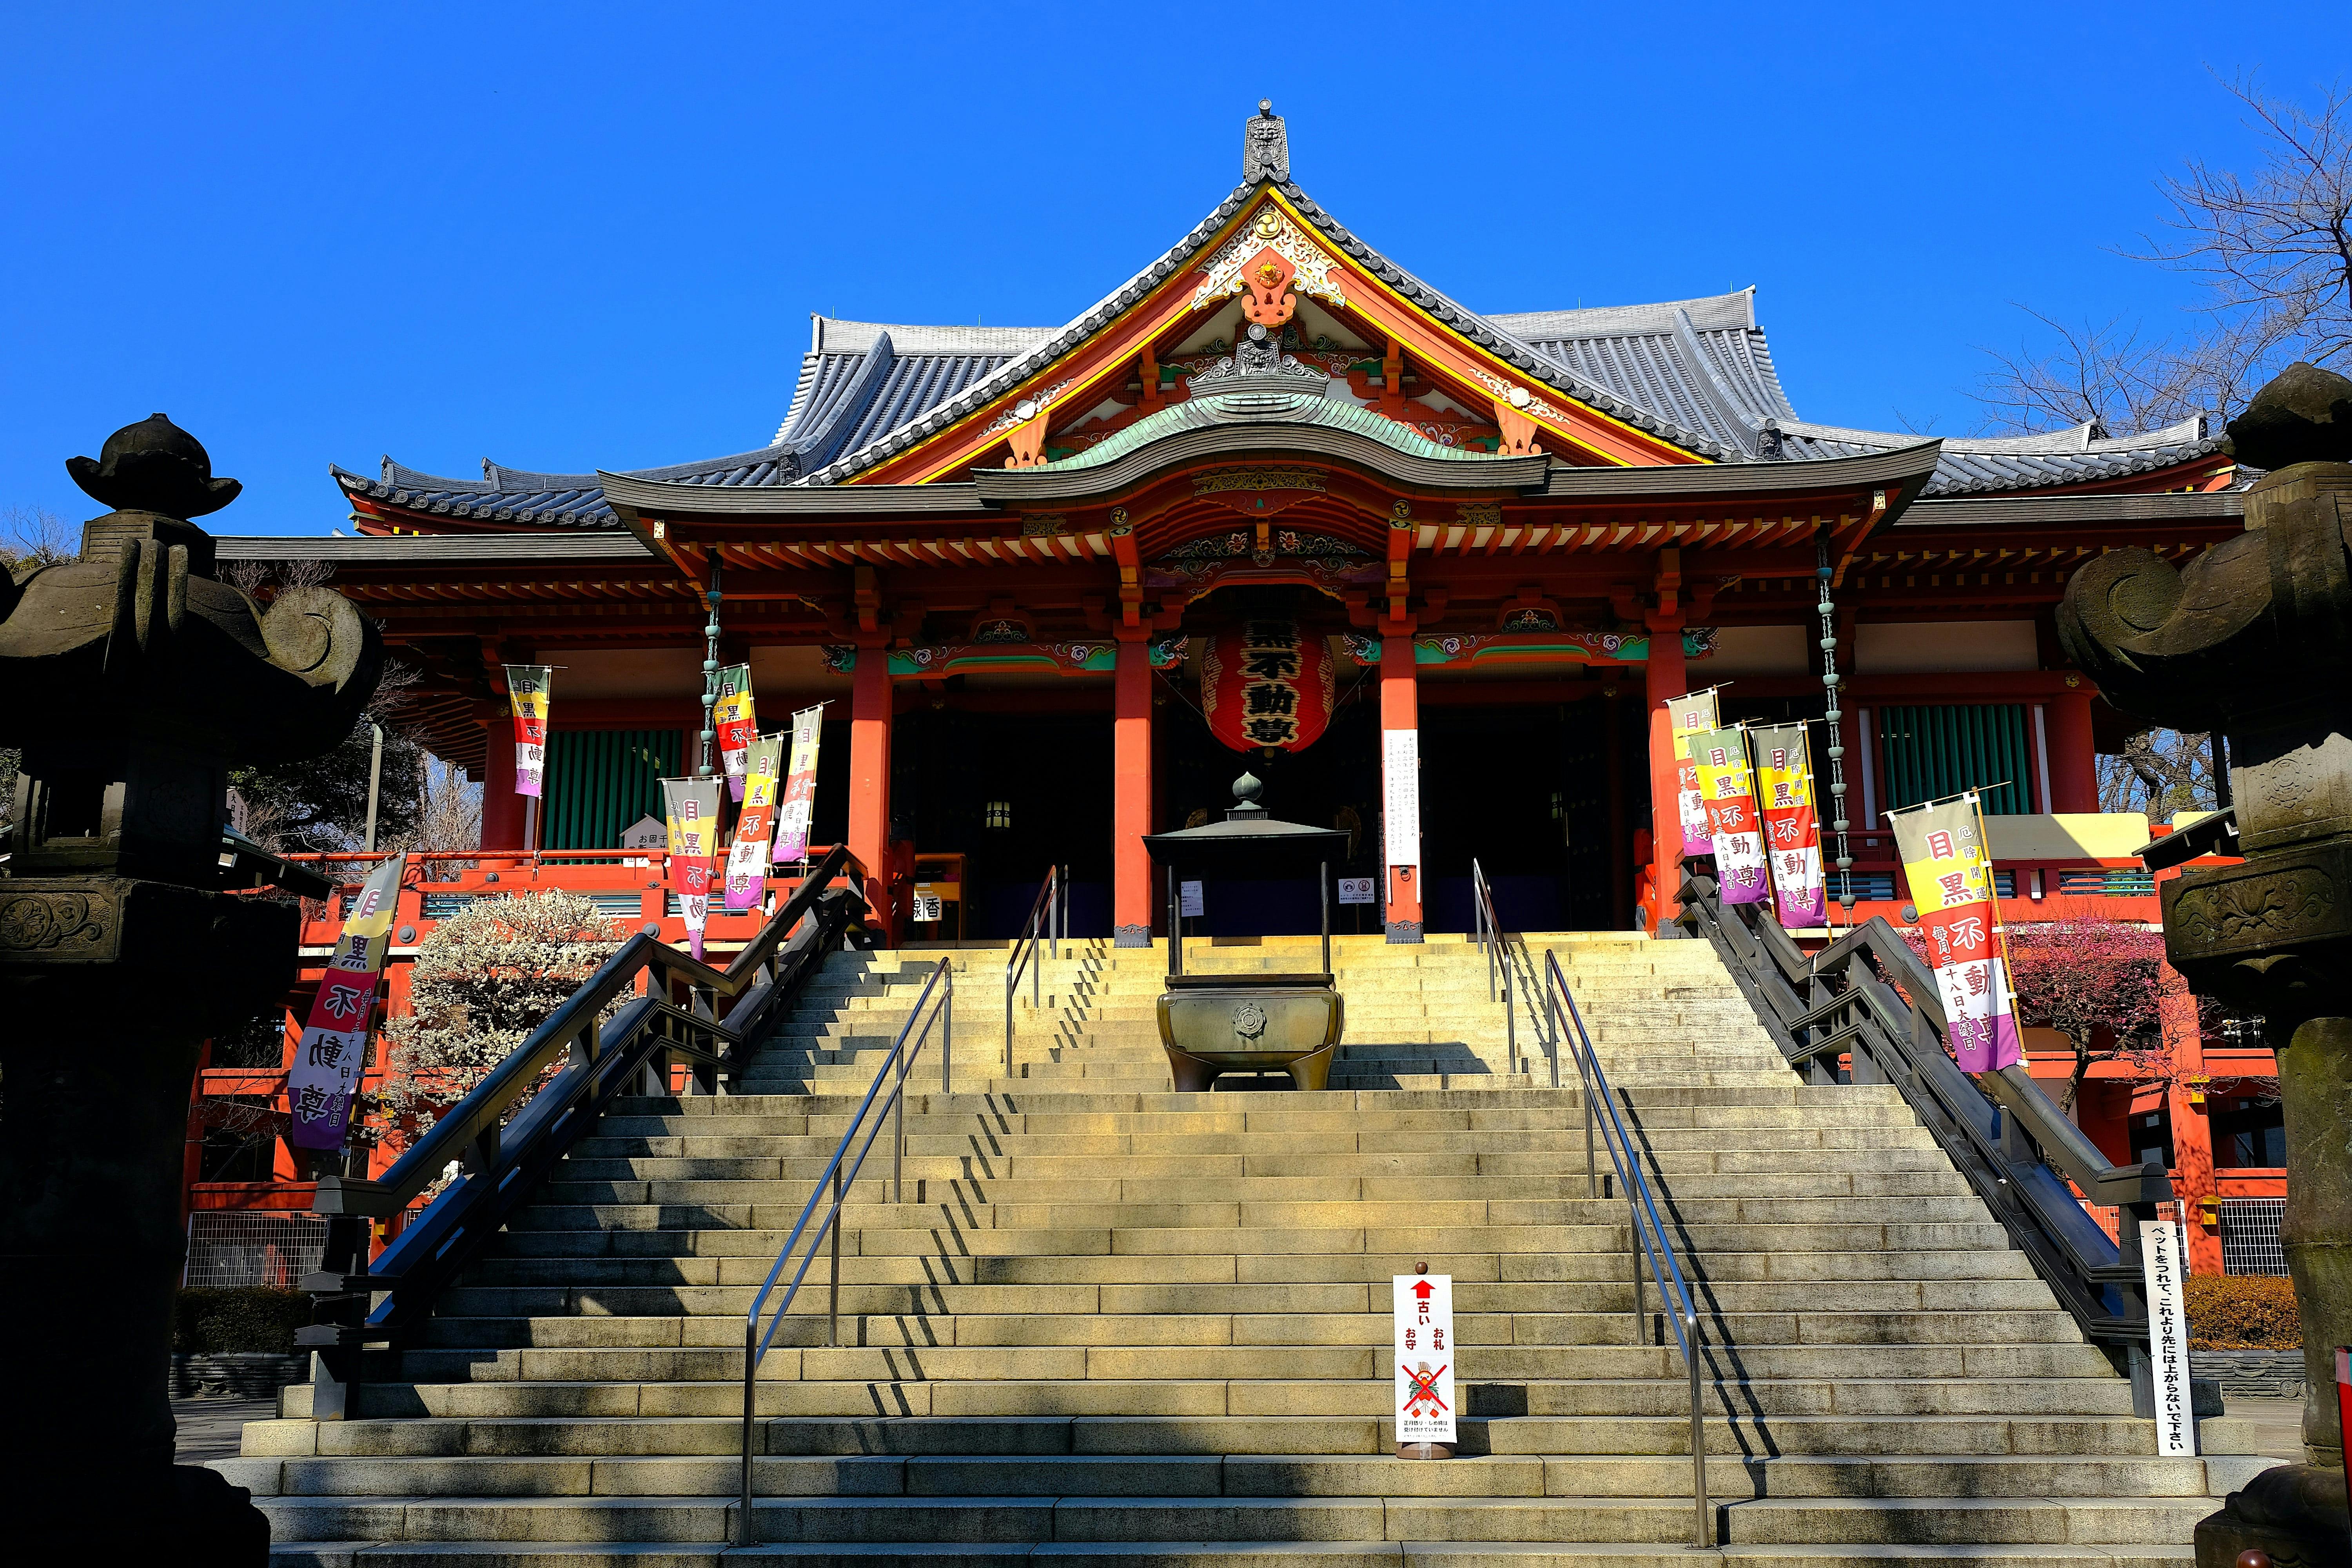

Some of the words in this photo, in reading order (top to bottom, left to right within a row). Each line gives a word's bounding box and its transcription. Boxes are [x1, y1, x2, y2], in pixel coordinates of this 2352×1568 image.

[1730, 747, 1746, 794] 厄除開運
[1789, 749, 1804, 805] 厄除開運
[731, 757, 768, 893] 目黒不動尊
[1710, 749, 1757, 887] 目黒不動尊
[1711, 809, 1735, 889] 毎月二十八日大縁日
[1772, 749, 1815, 909] 目黒不動尊
[1958, 826, 1987, 899] 厄除開運
[1927, 831, 1993, 1046] 目黒不動尊
[1933, 926, 1976, 1050] 毎月二十八日大縁日
[1405, 1328, 1416, 1350] お守
[1417, 1301, 1430, 1325] 古い
[1434, 1328, 1444, 1350] お札
[2151, 1227, 2183, 1450] ペットをつれて、これより先には上がらないで下さい
